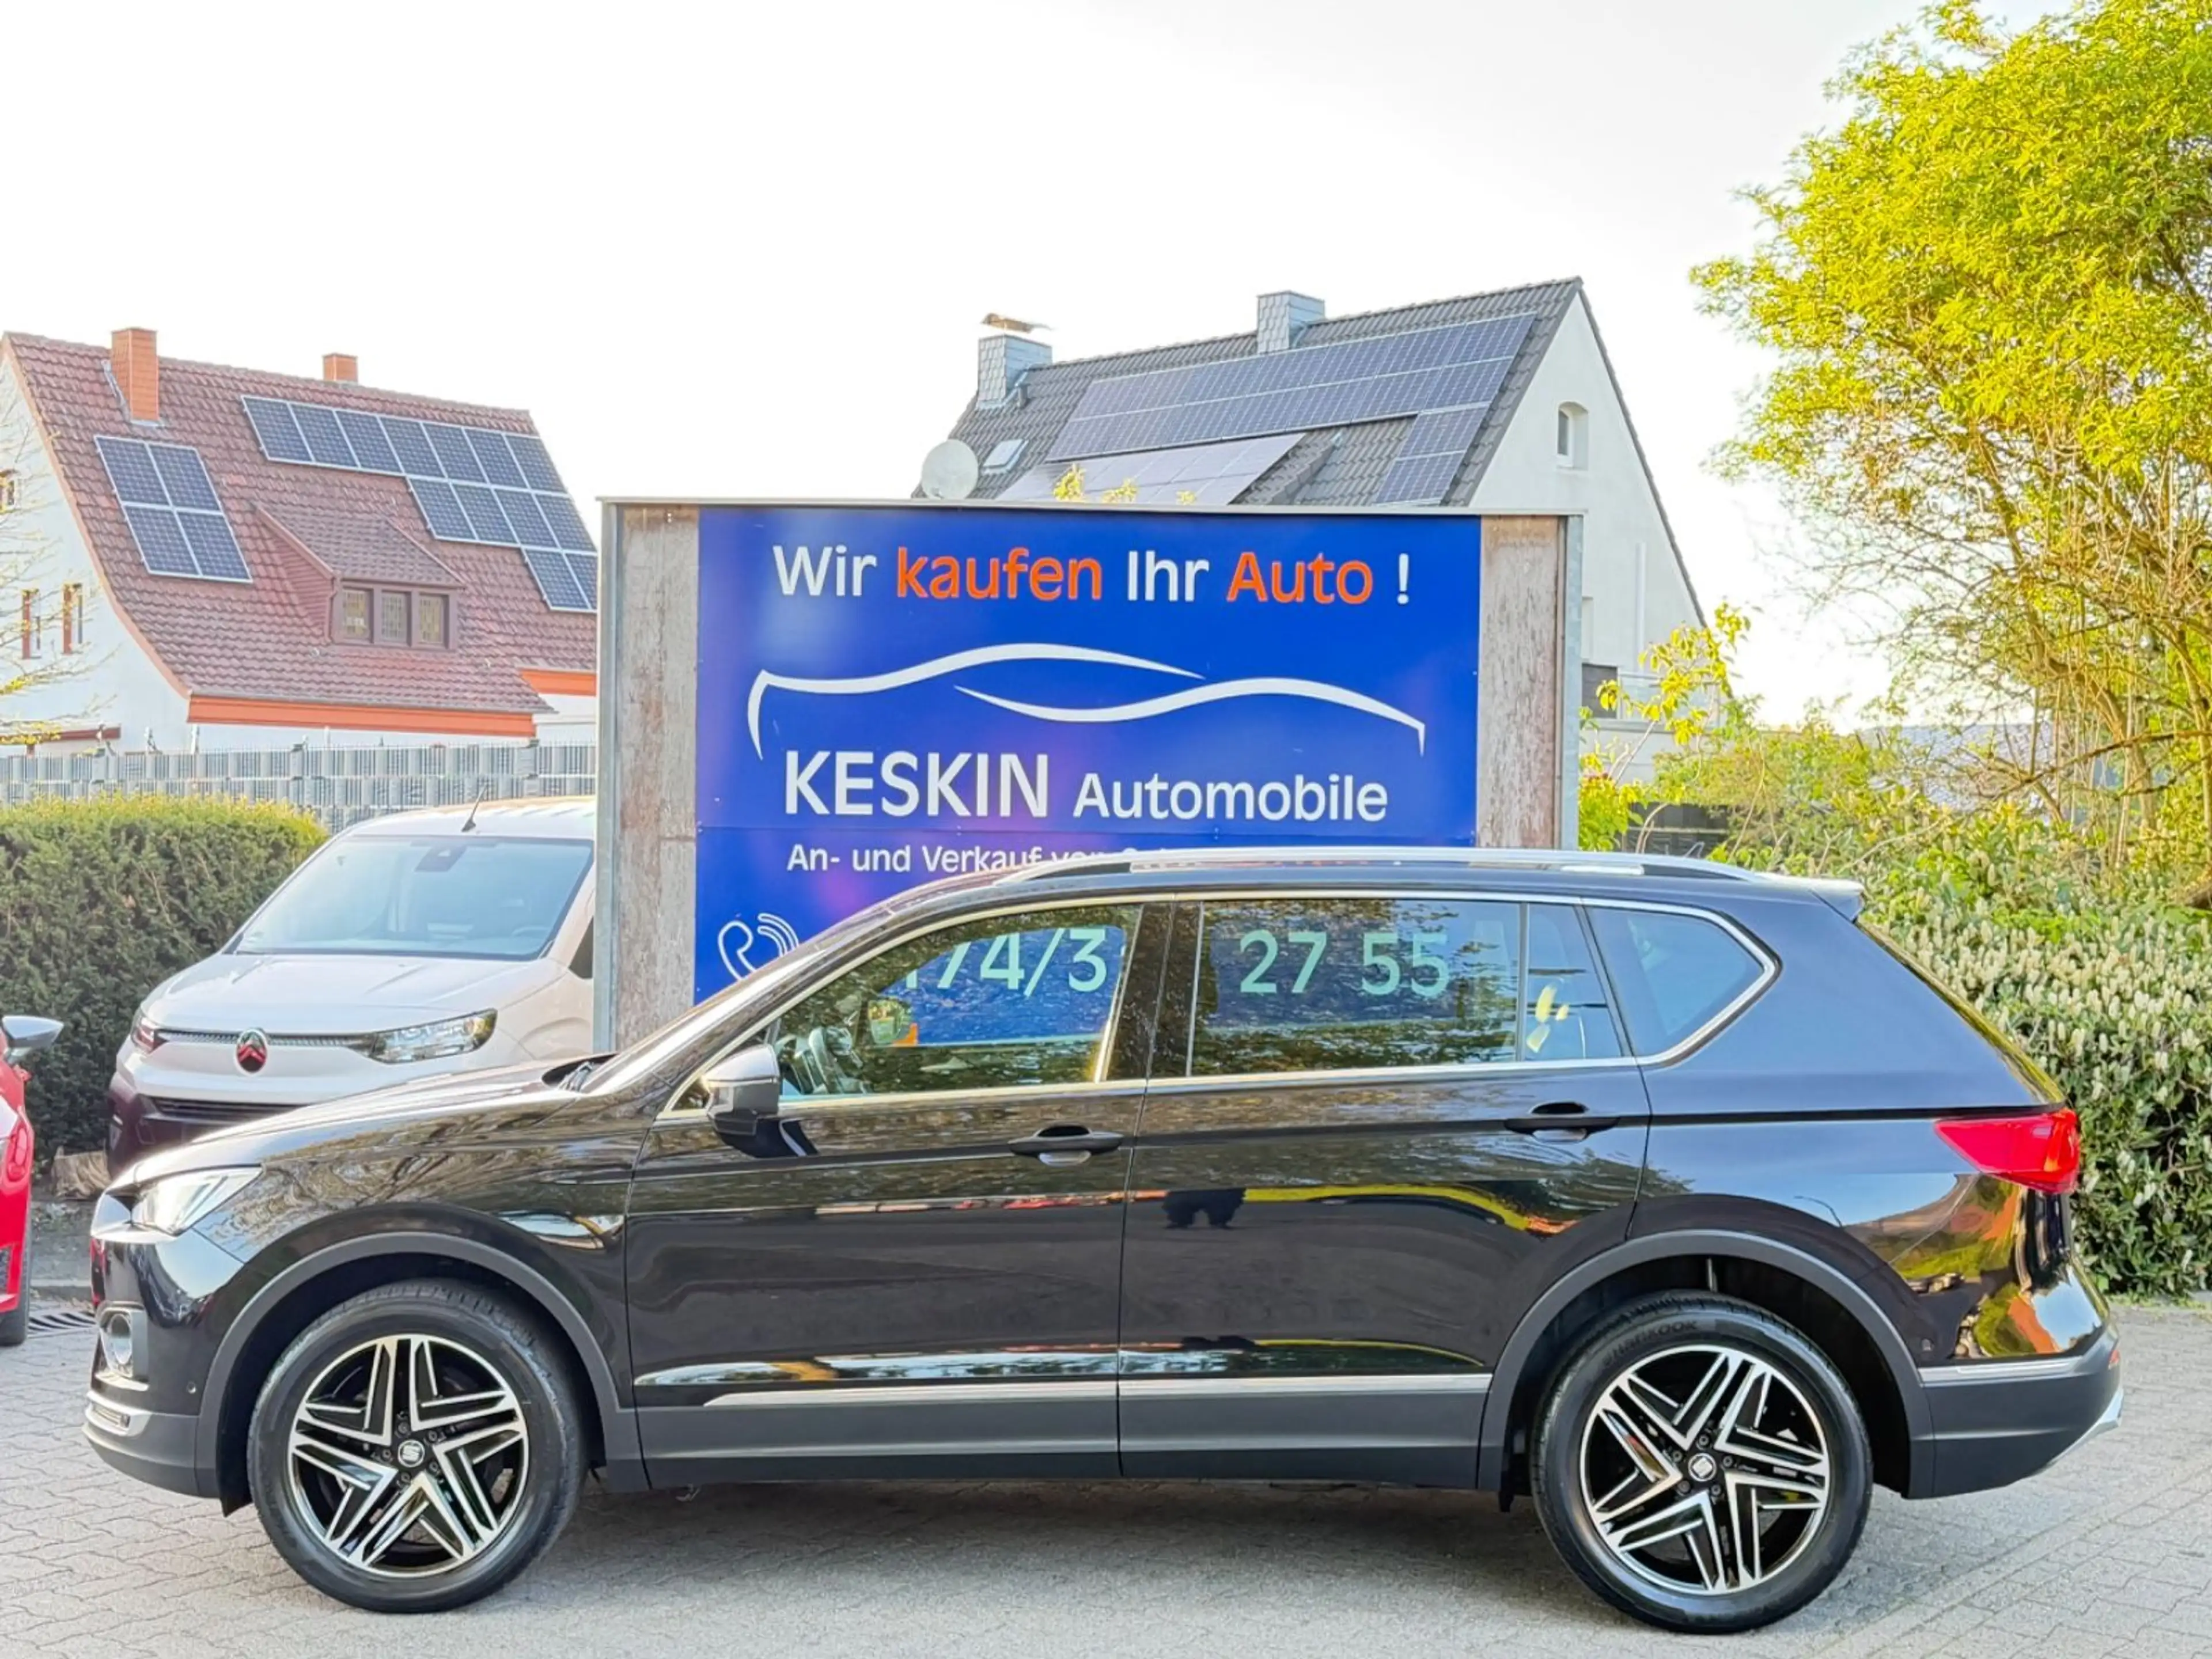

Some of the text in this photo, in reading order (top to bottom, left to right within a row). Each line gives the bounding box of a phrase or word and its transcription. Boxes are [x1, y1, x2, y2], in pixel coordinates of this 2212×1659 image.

[772, 544, 1410, 604] Wir kaufen Ihr Auto !
[785, 750, 1388, 821] KESKIN Automobile
[787, 843, 840, 872] An-
[853, 844, 911, 873] und
[922, 845, 1043, 873] Verkauf
[1240, 929, 1327, 994] 27
[1361, 932, 1450, 998] 55
